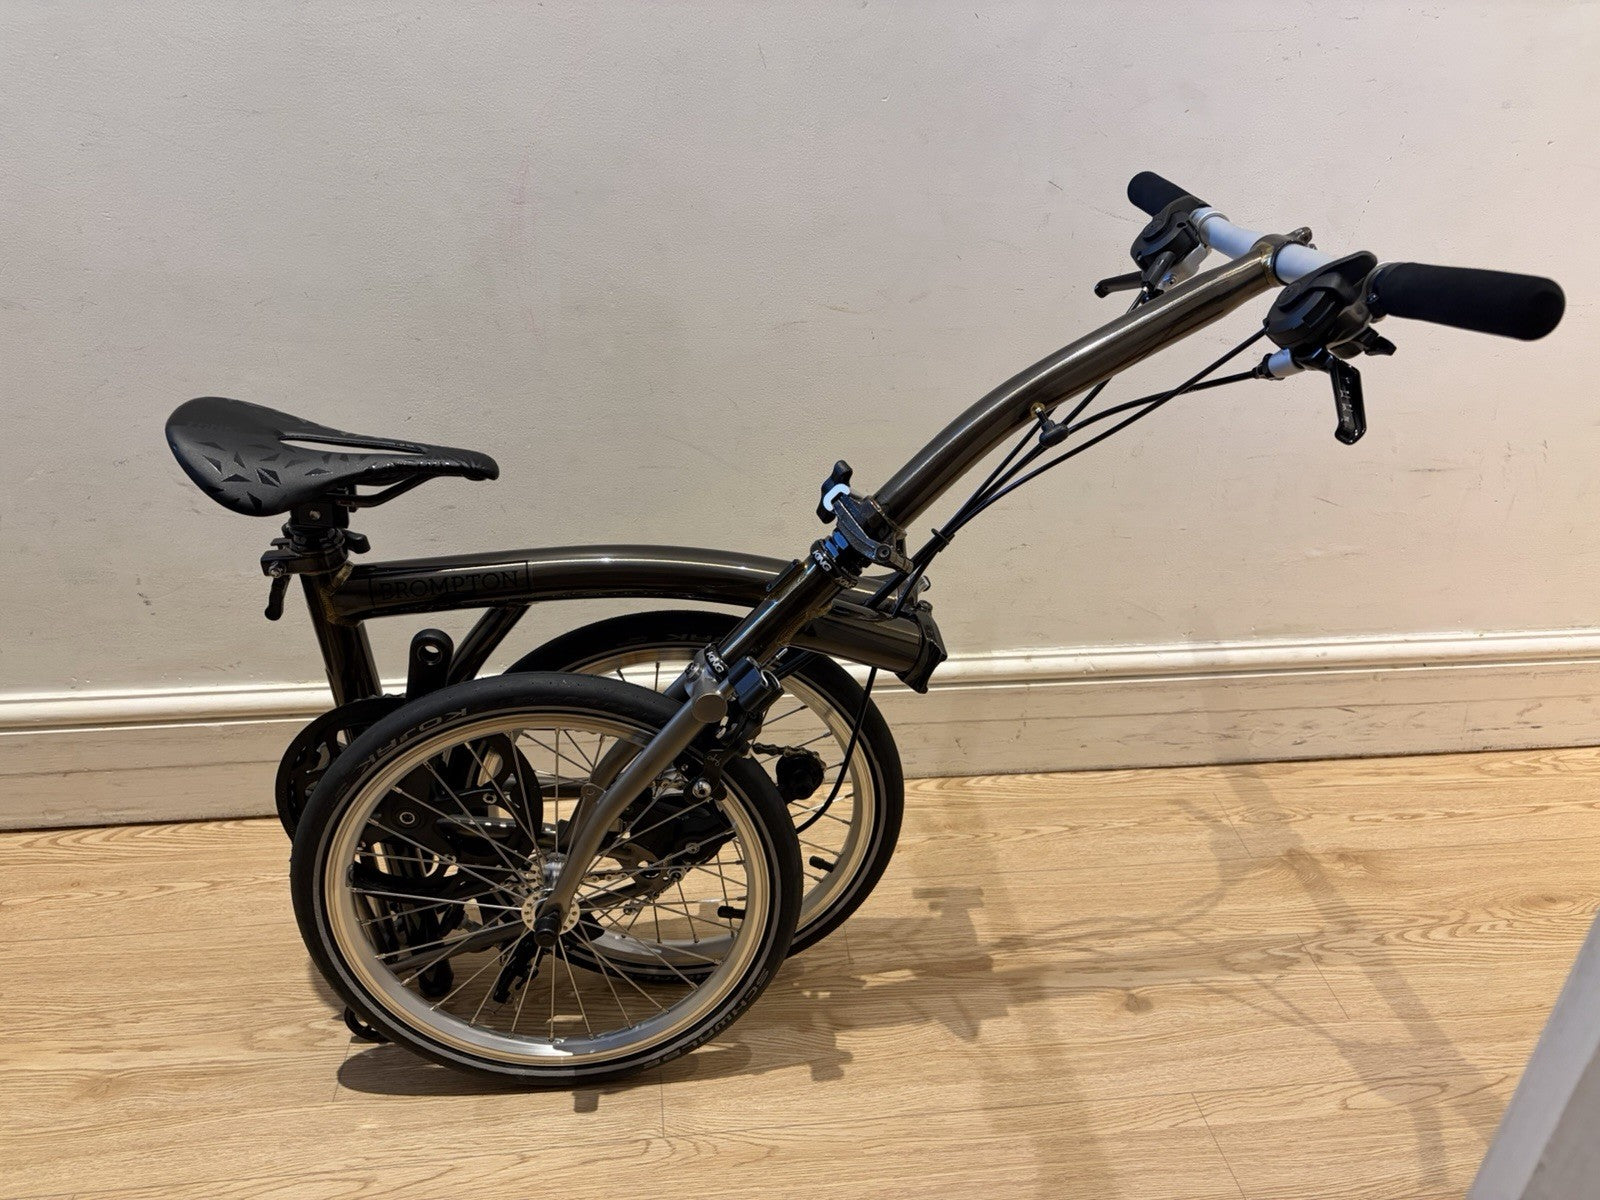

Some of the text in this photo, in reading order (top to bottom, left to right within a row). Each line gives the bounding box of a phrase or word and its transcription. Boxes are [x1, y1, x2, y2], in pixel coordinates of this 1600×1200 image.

[812, 550, 832, 571] KING
[380, 570, 519, 600] BROMPTON
[706, 651, 725, 673] KING
[357, 707, 467, 773] KOJAK
[642, 967, 770, 1069] SCHWALBE
